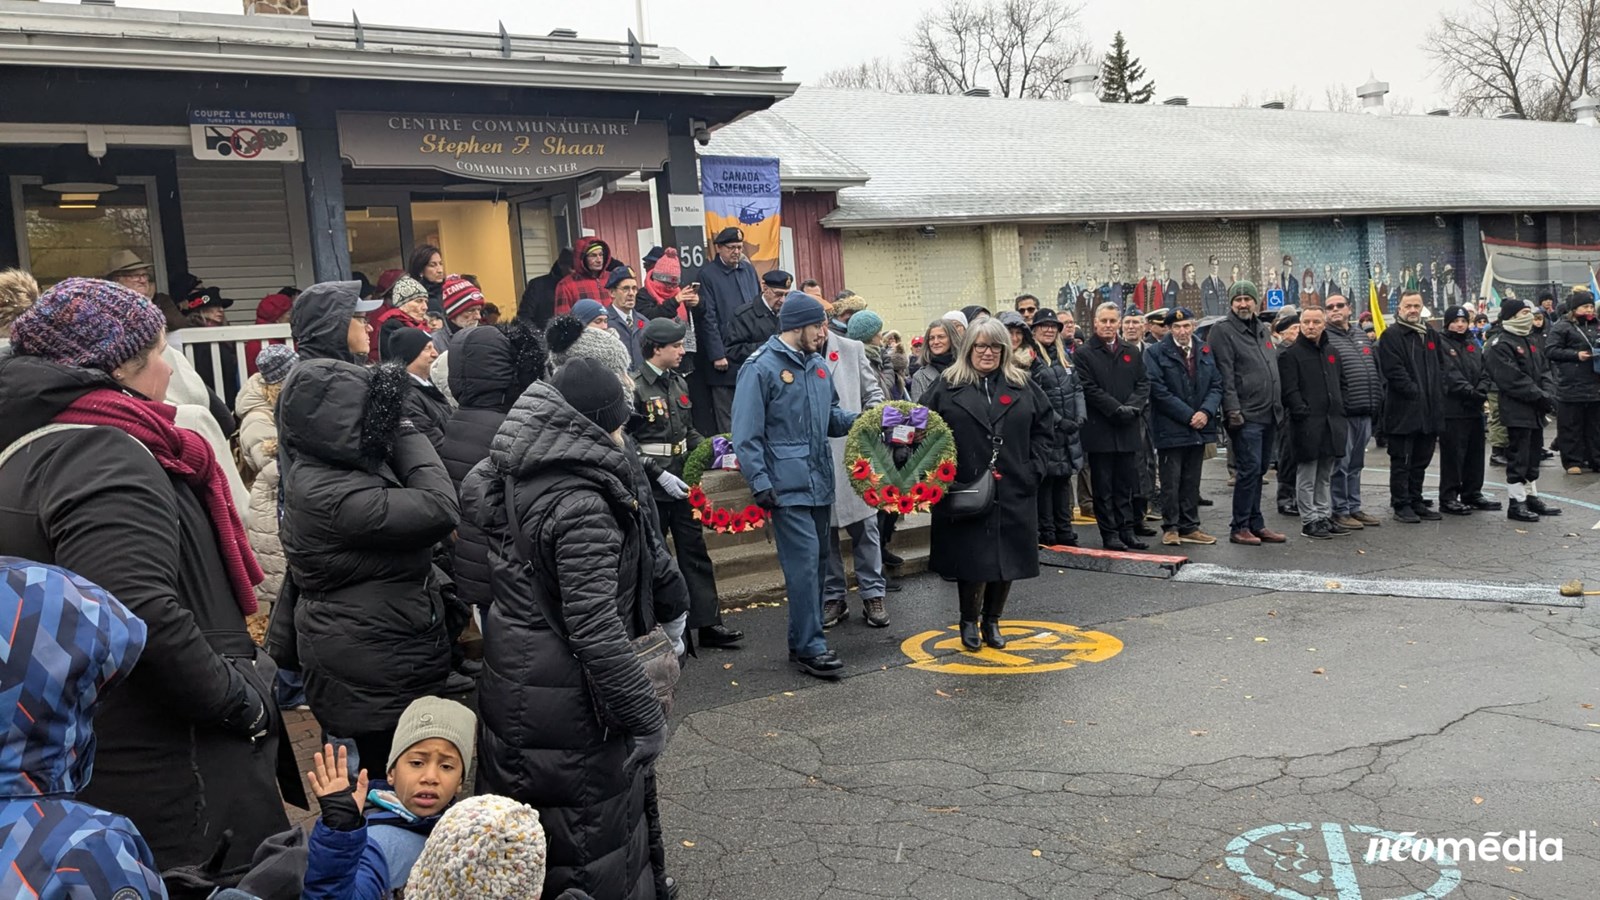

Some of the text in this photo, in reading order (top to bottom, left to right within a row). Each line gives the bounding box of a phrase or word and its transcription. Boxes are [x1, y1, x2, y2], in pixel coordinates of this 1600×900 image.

[194, 110, 231, 118] COUPEZ
[388, 117, 629, 136] CENTRE COMMUNAUTAIRE
[419, 133, 503, 159] Stephen
[540, 136, 605, 156] Shaar
[456, 160, 578, 176] COMMUNITY CENTER
[722, 170, 760, 182] CANADA
[713, 182, 771, 193] REMEMBERS
[680, 245, 704, 268] 56
